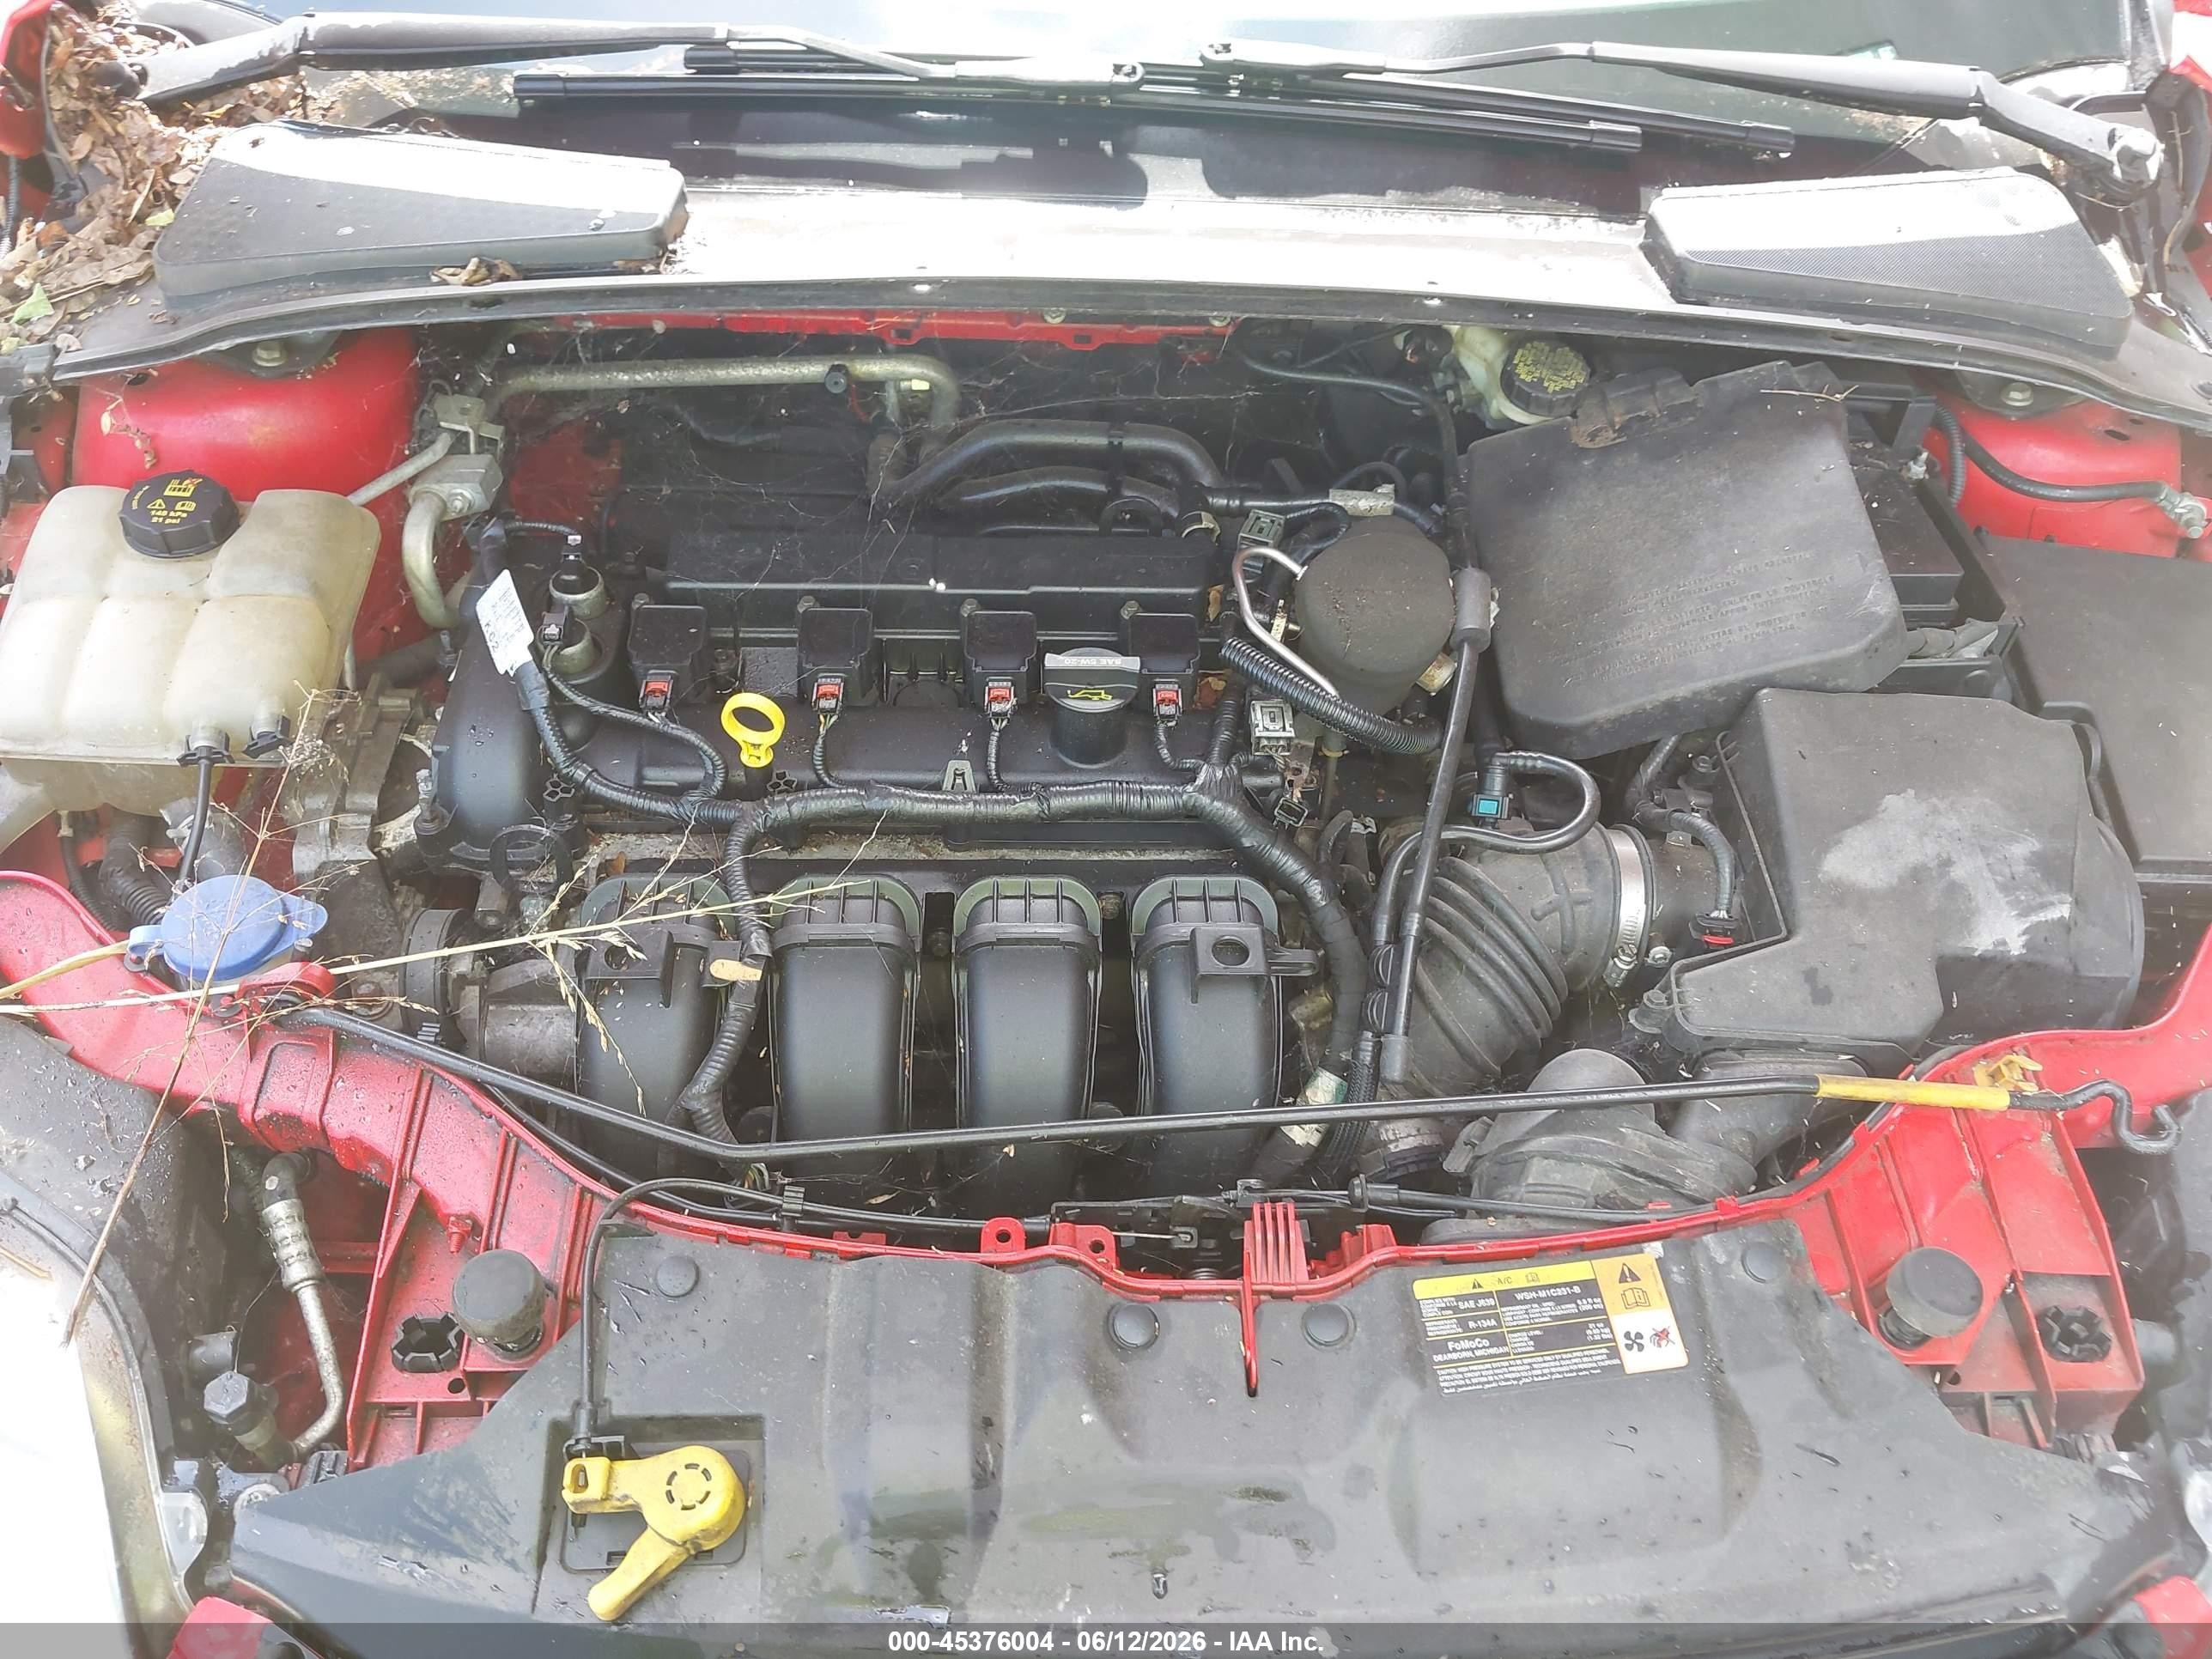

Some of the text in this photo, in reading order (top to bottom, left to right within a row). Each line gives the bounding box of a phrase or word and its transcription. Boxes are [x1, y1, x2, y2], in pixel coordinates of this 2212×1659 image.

[1498, 1276, 1512, 1285] A/C
[1458, 1299, 1476, 1310] SAE
[1468, 1318, 1498, 1329] R-134A
[1447, 1338, 1490, 1352] FoMoCo
[1474, 1346, 1509, 1355] MICHIGAN
